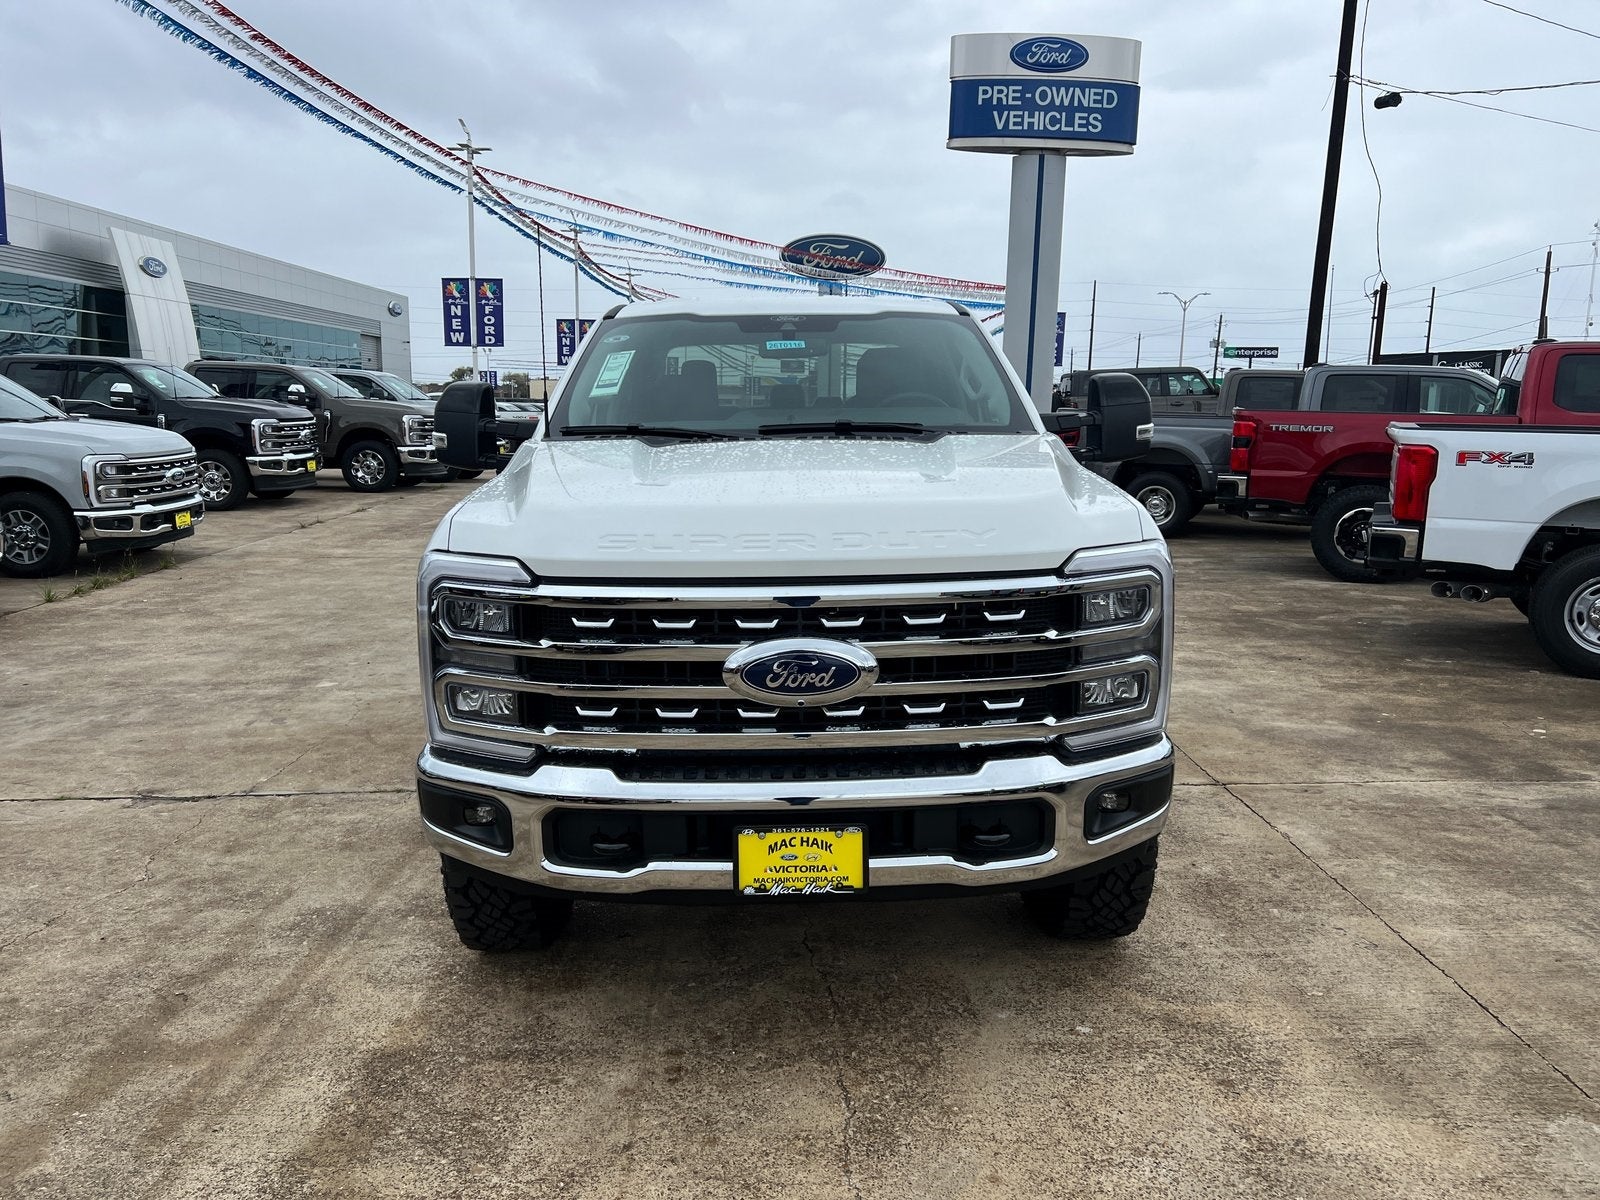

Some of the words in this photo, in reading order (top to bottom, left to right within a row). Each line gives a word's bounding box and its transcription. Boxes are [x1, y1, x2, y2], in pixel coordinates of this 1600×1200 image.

[1027, 42, 1072, 64] Ford
[993, 110, 1102, 133] VEHICLES
[803, 242, 864, 269] Ford
[450, 305, 465, 343] NEW
[483, 305, 496, 344] FORD
[1225, 348, 1278, 357] enterprise
[1269, 424, 1334, 432] TREMOR
[1455, 450, 1535, 466] FX4
[597, 532, 816, 552] SUPER
[832, 528, 998, 551] DUTY
[765, 659, 837, 688] Ford
[768, 836, 797, 855] MAC
[800, 836, 834, 855] HAIK
[773, 865, 828, 873] VICTORIA
[769, 882, 800, 895] Mac
[801, 882, 836, 895] Haik
